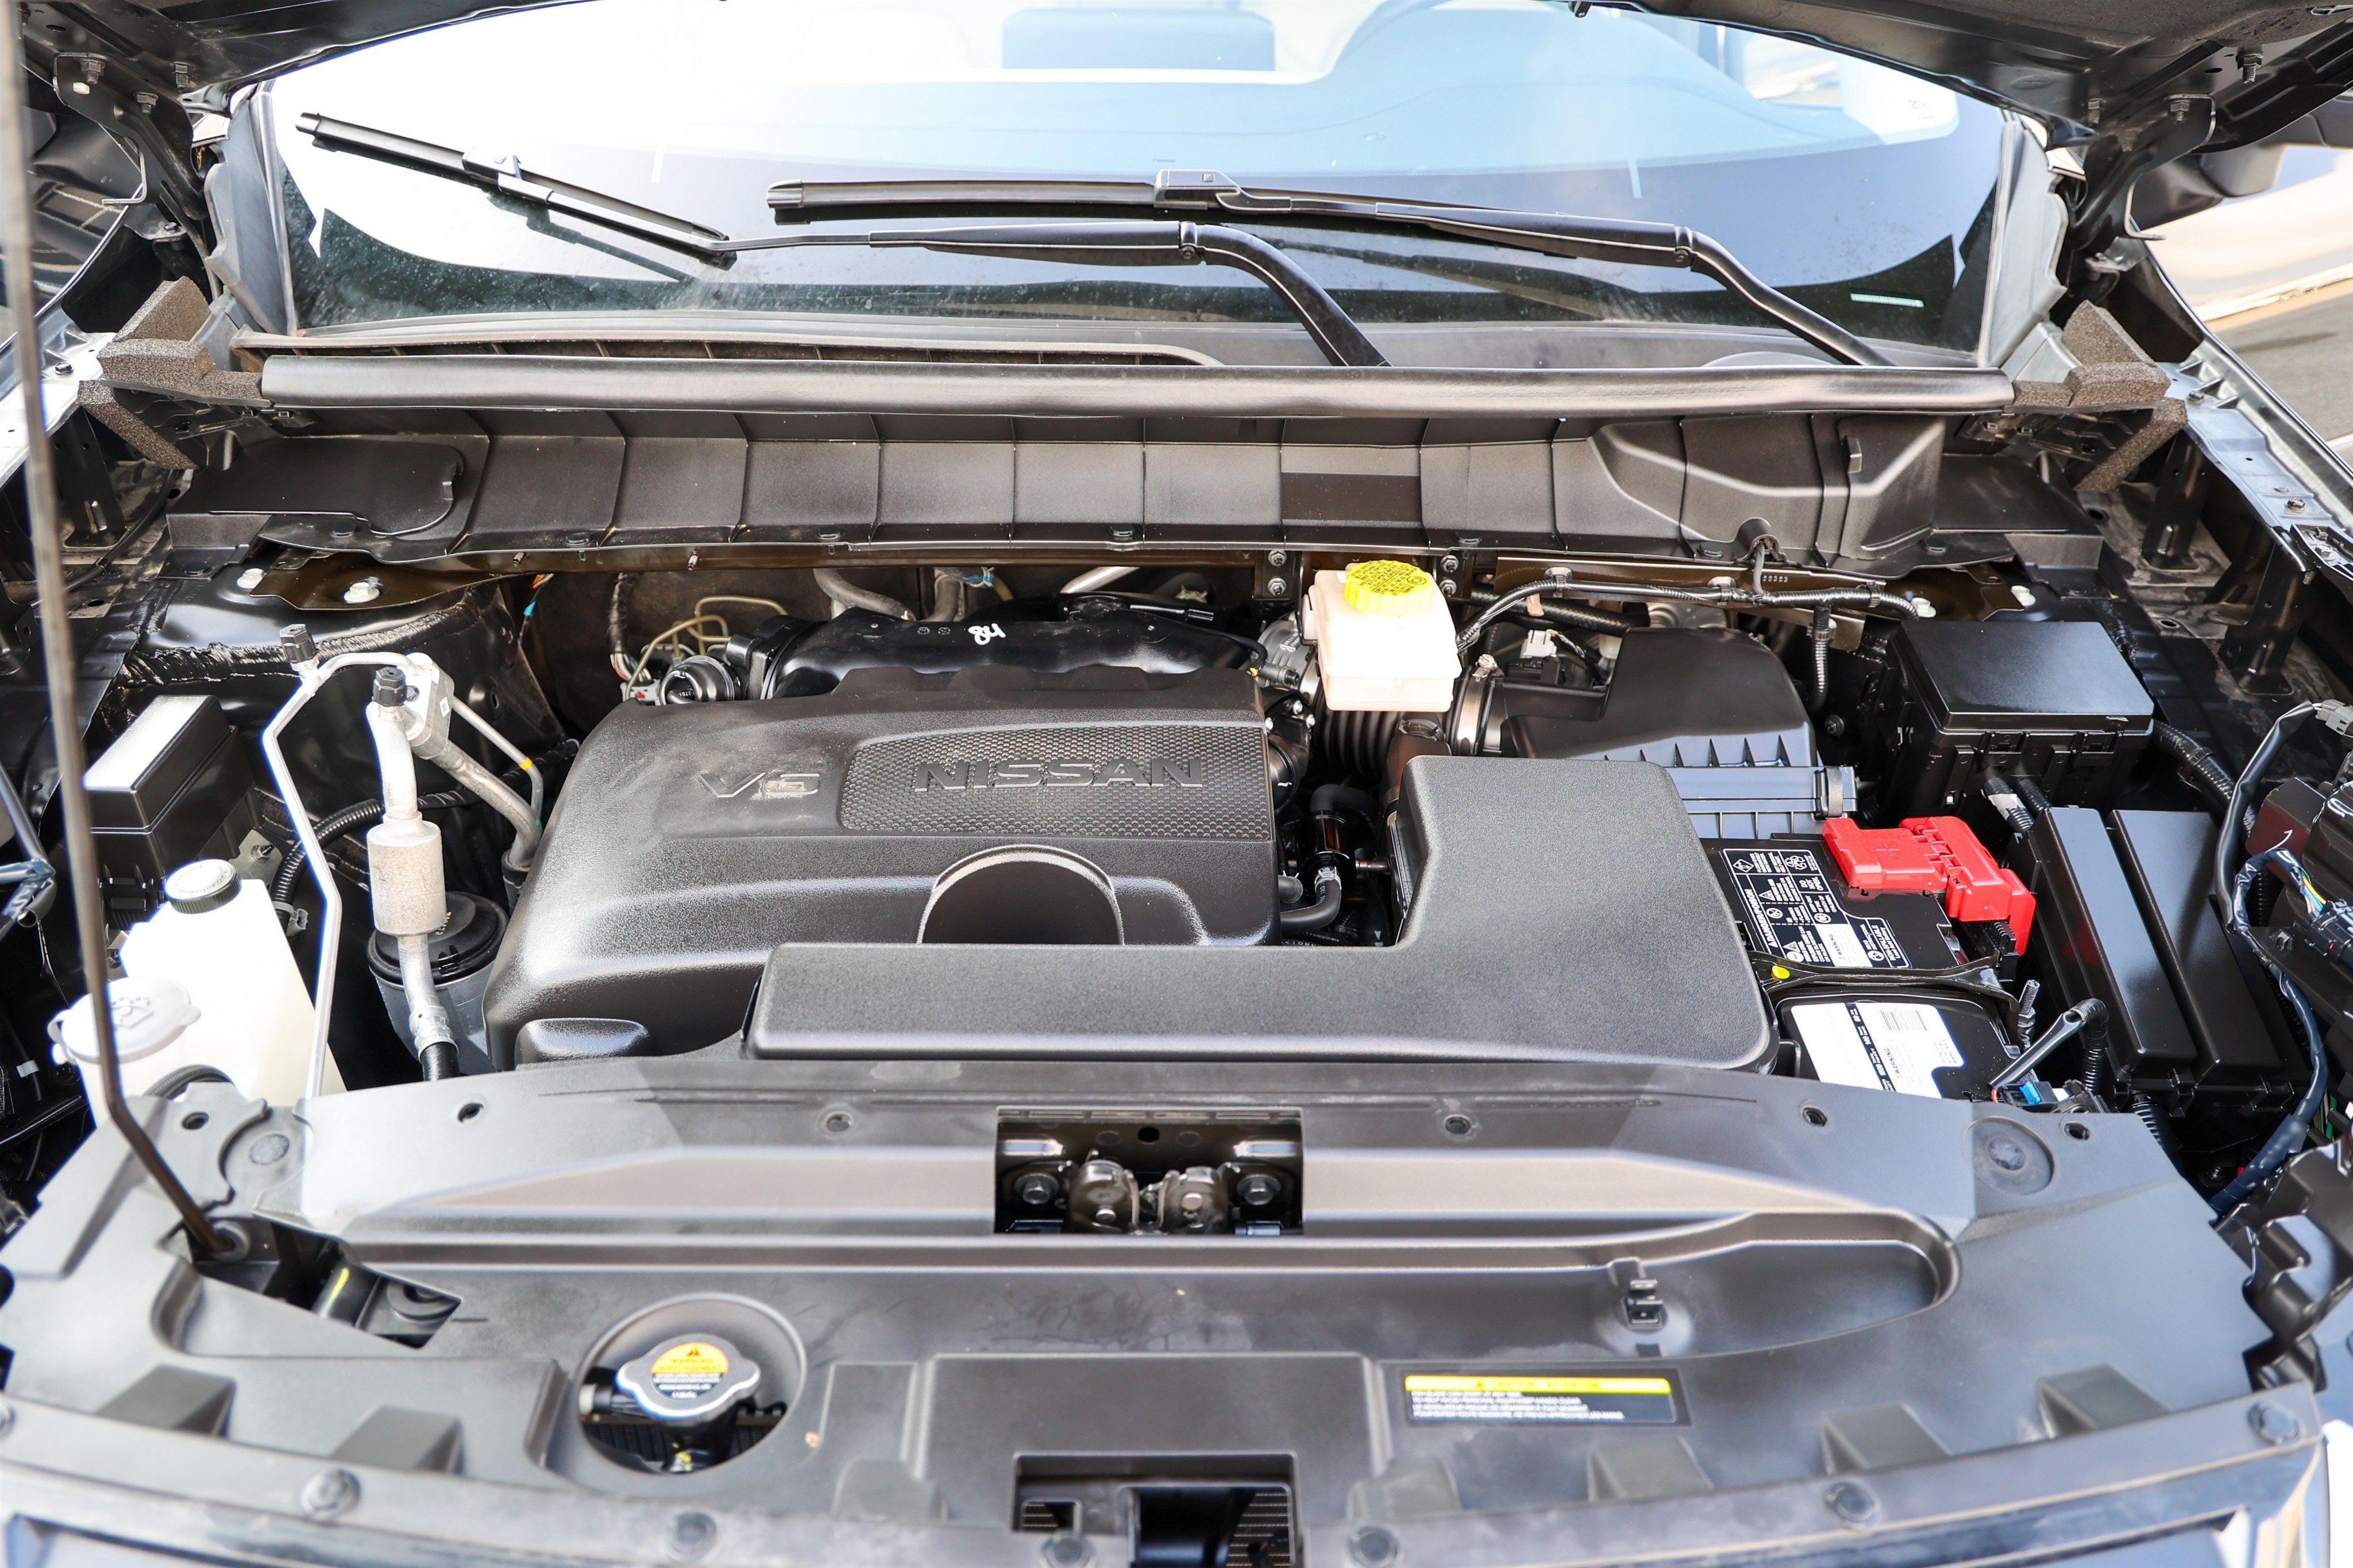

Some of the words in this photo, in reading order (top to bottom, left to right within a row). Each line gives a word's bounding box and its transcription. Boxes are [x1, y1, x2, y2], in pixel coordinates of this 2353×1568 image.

[967, 623, 1006, 645] 84
[915, 756, 1203, 793] NISSAN
[697, 771, 820, 799] V6
[1805, 879, 1816, 889] NOT
[1808, 903, 1817, 912] KEEP
[1820, 901, 1830, 912] REACH
[1743, 889, 1775, 941] DANGER/POISON
[1862, 1036, 1872, 1044] 140
[1875, 1064, 1887, 1075] 1000
